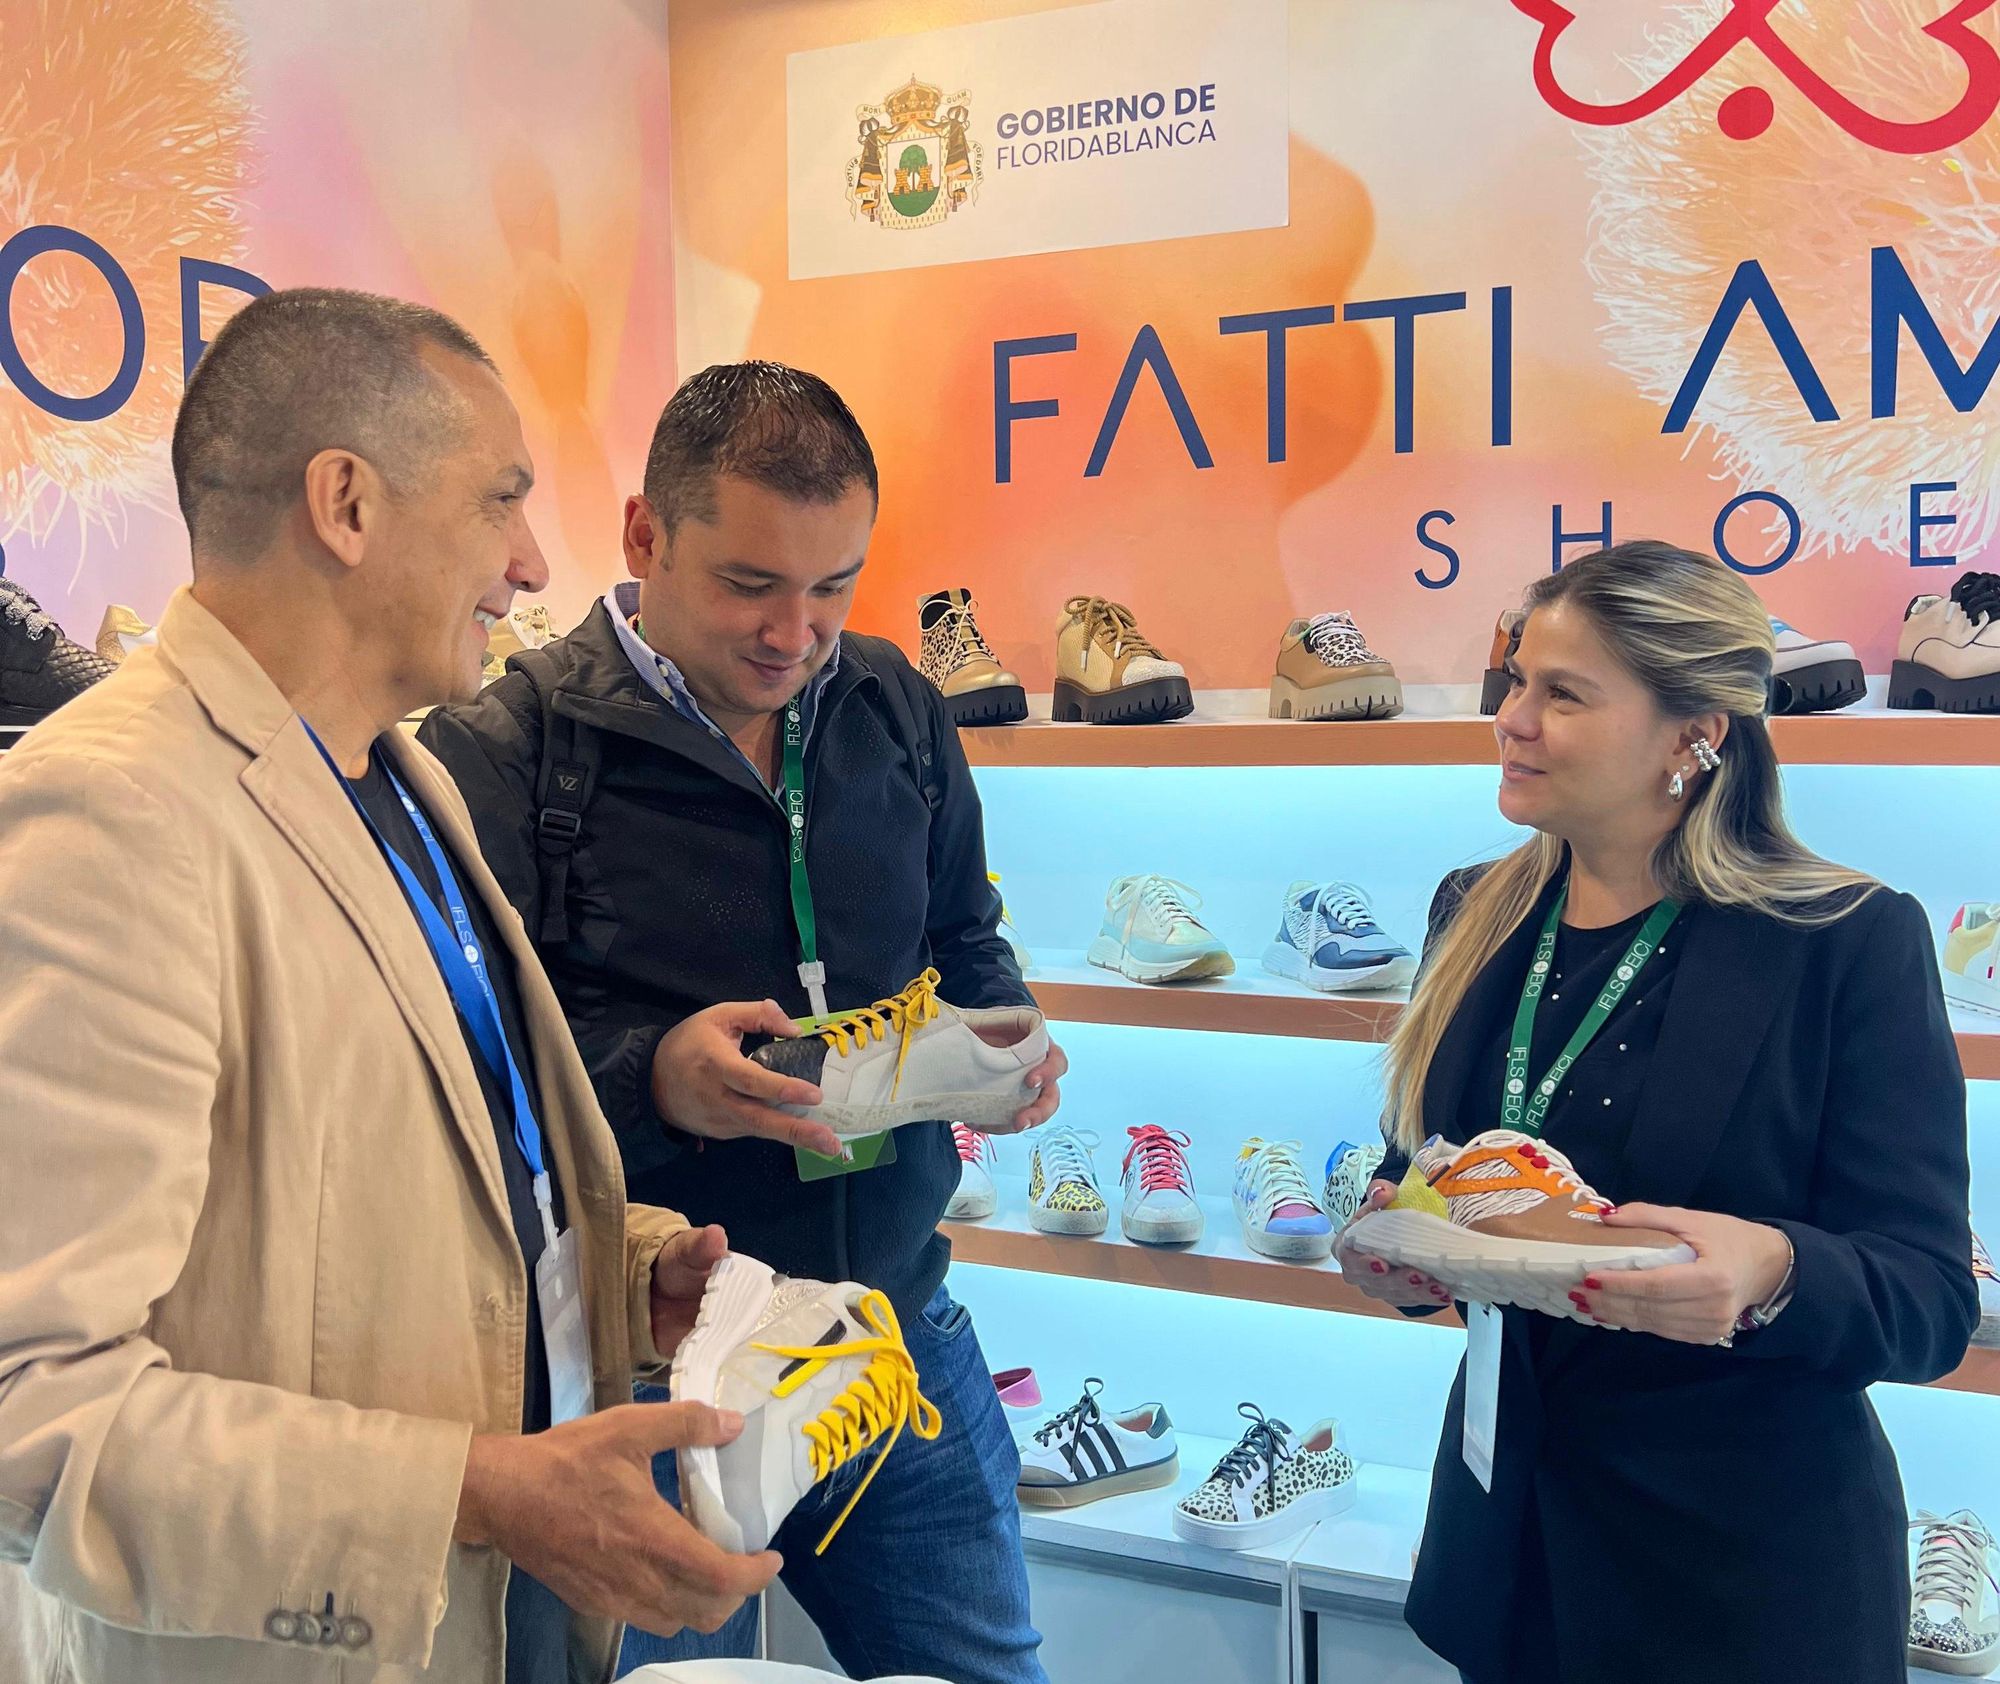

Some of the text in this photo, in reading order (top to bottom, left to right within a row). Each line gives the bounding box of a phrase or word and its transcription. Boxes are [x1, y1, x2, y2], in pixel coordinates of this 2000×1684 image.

[863, 105, 881, 115] MORI
[996, 83, 1216, 139] GOBIERNO DE
[997, 118, 1217, 170] FLORIDABLANCA
[846, 158, 859, 187] POTIUS
[992, 285, 1513, 485] FATTI
[1415, 481, 1958, 589] SHOE
[787, 695, 801, 746] IFLS EIC
[557, 775, 578, 791] VZ
[790, 789, 804, 814] EICI
[451, 905, 473, 944] IFLS
[1525, 931, 1555, 998] IFLS EICI
[1597, 939, 1653, 1011] IFLS EICI
[1504, 1046, 1527, 1125] IFLS EICI
[1525, 1054, 1575, 1130] IFLS EICI
